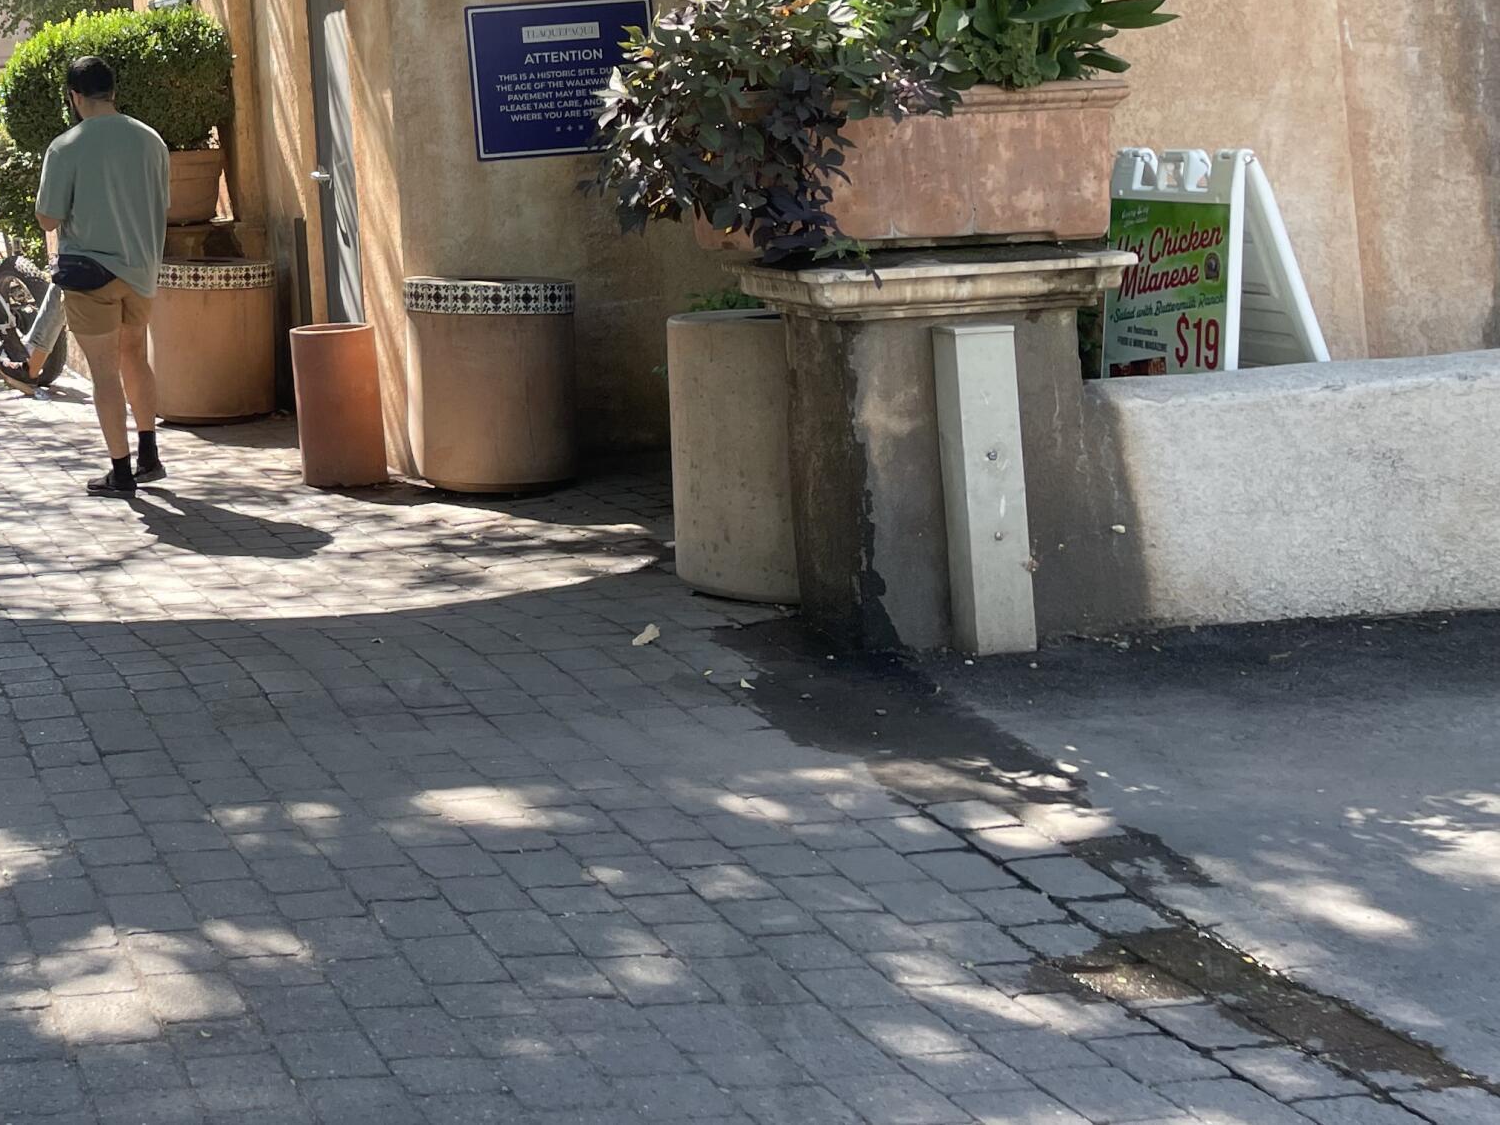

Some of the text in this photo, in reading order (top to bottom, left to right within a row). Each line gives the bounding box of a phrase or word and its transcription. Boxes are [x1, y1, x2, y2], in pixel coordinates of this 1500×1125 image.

[524, 48, 603, 65] ATTENTION
[498, 74, 518, 82] THIS
[519, 73, 527, 81] IS
[537, 69, 576, 79] HISTORIC
[496, 84, 513, 92] THE
[514, 82, 532, 91] AGE
[534, 82, 545, 90] OF
[547, 80, 565, 88] THE
[508, 91, 553, 102] PAVEMENT
[556, 89, 574, 98] MAY
[576, 88, 587, 97] BE
[499, 103, 532, 112] PLEASE
[534, 101, 555, 110] TAKE
[510, 112, 543, 122] WHERE
[545, 110, 563, 119] YOU
[564, 109, 581, 118] ARE
[1149, 221, 1223, 263] Chicken
[1117, 263, 1200, 302] Milanese
[1174, 311, 1220, 371] $19
